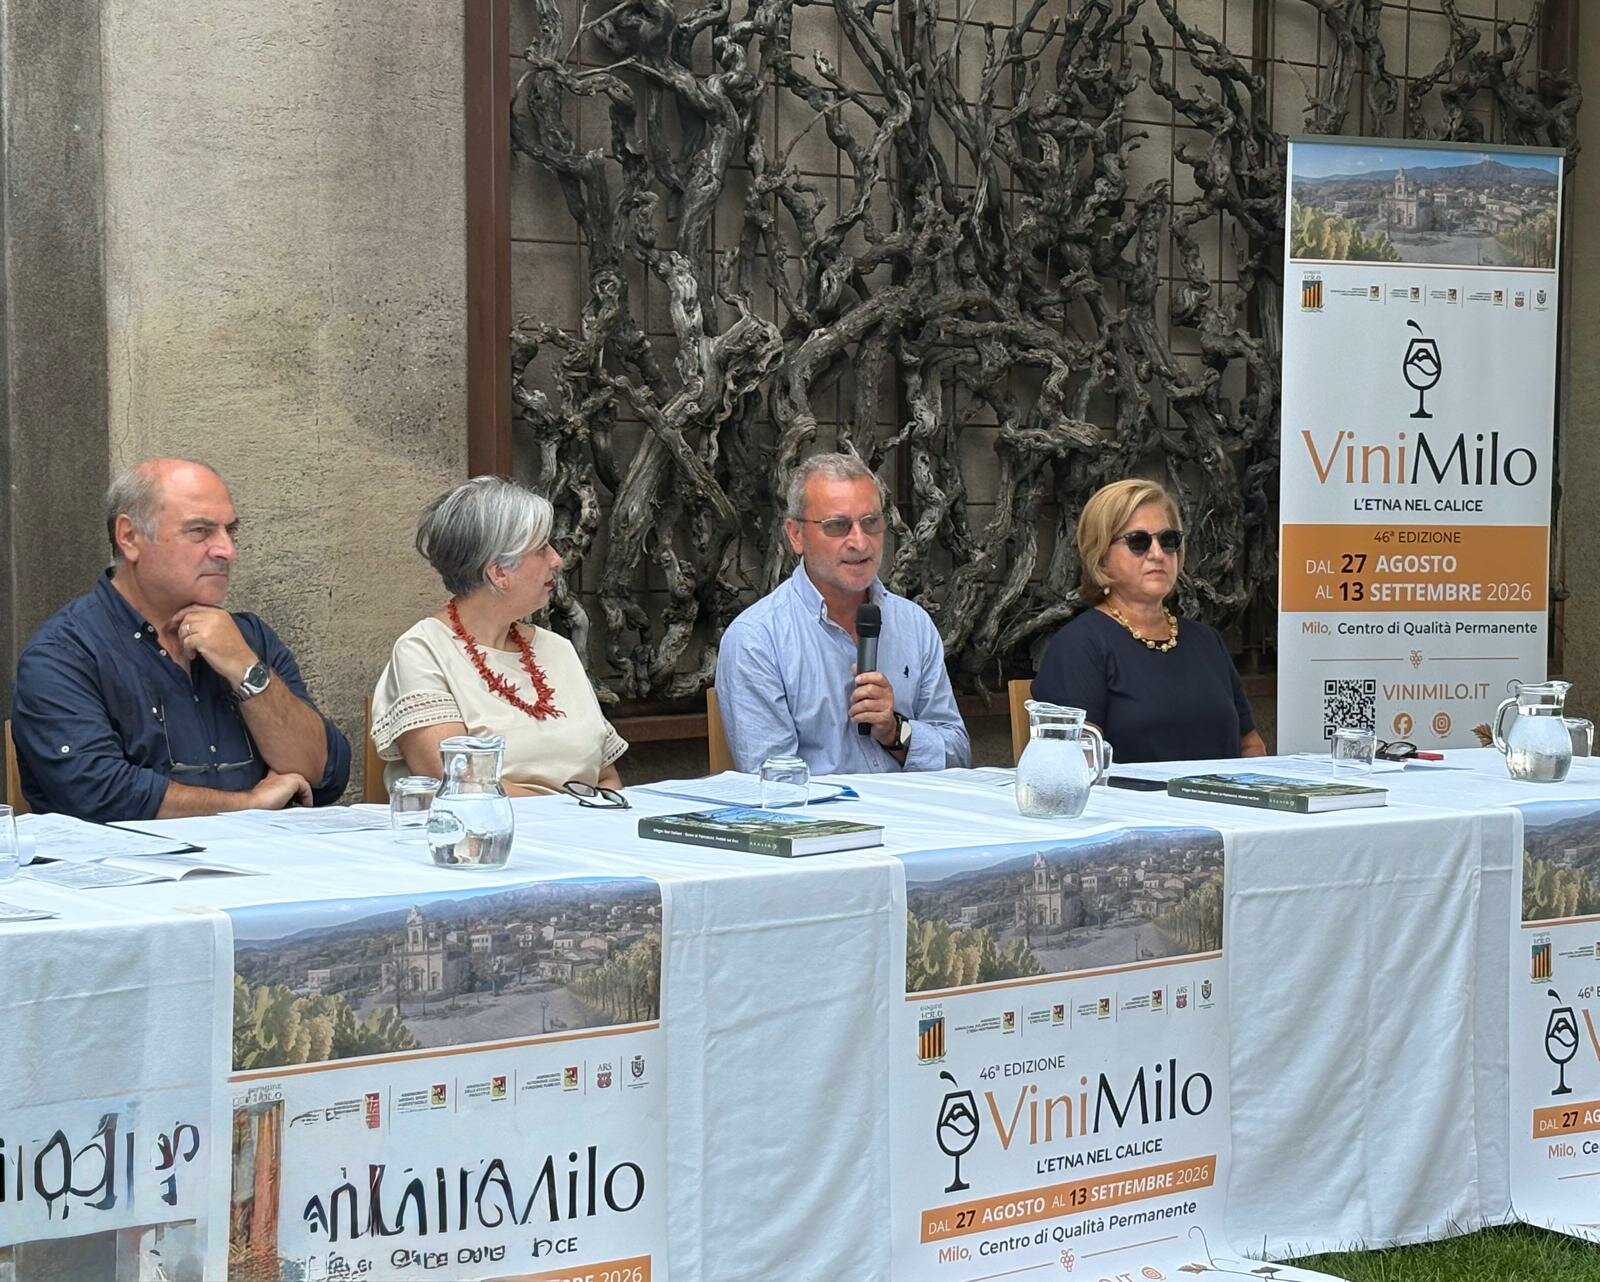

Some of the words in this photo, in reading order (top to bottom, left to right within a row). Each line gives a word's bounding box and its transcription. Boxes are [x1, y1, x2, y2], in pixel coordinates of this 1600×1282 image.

[1301, 430, 1538, 486] ViniMilo
[1354, 498, 1402, 511] L'ETNA
[1404, 499, 1432, 511] NEL
[1434, 499, 1484, 512] CALICE
[1398, 531, 1462, 544] EDIZIONE
[1306, 559, 1335, 574] DAL
[1341, 554, 1367, 574] 27
[1375, 555, 1457, 574] AGOSTO
[1315, 585, 1334, 599] AL
[1339, 582, 1364, 601] 13
[1370, 583, 1482, 601] SETTEMBRE
[1487, 583, 1532, 601] 2026
[1302, 621, 1332, 636] Milo,
[1337, 623, 1384, 635] Centro
[1387, 621, 1400, 634] di
[1403, 621, 1451, 636] Qualità
[1455, 621, 1538, 634] Permanente
[1383, 683, 1490, 701] VINIMILO.IT
[597, 1062, 612, 1072] ARS
[1004, 1055, 1066, 1077] EDIZIONE
[984, 1058, 1213, 1151] ViniMilo
[1540, 1119, 1559, 1131] DAL
[1562, 1111, 1579, 1128] 27
[1036, 1153, 1085, 1175] L'ETNA
[1087, 1148, 1113, 1166] NEL
[1115, 1138, 1163, 1160] CALICE
[1548, 1143, 1577, 1159] Milo,
[928, 1220, 951, 1236] DAL
[955, 1210, 977, 1229] 27
[982, 1197, 1046, 1224] AGOSTO
[1052, 1195, 1066, 1209] AL
[1069, 1187, 1088, 1207] 13
[1091, 1172, 1174, 1201] SETTEMBRE
[1176, 1164, 1209, 1186] 2026
[939, 1246, 972, 1264] Milo,
[979, 1236, 1031, 1256] Centro
[1034, 1228, 1049, 1244] di
[1052, 1217, 1105, 1243] Qualità
[1109, 1201, 1197, 1230] Permanente
